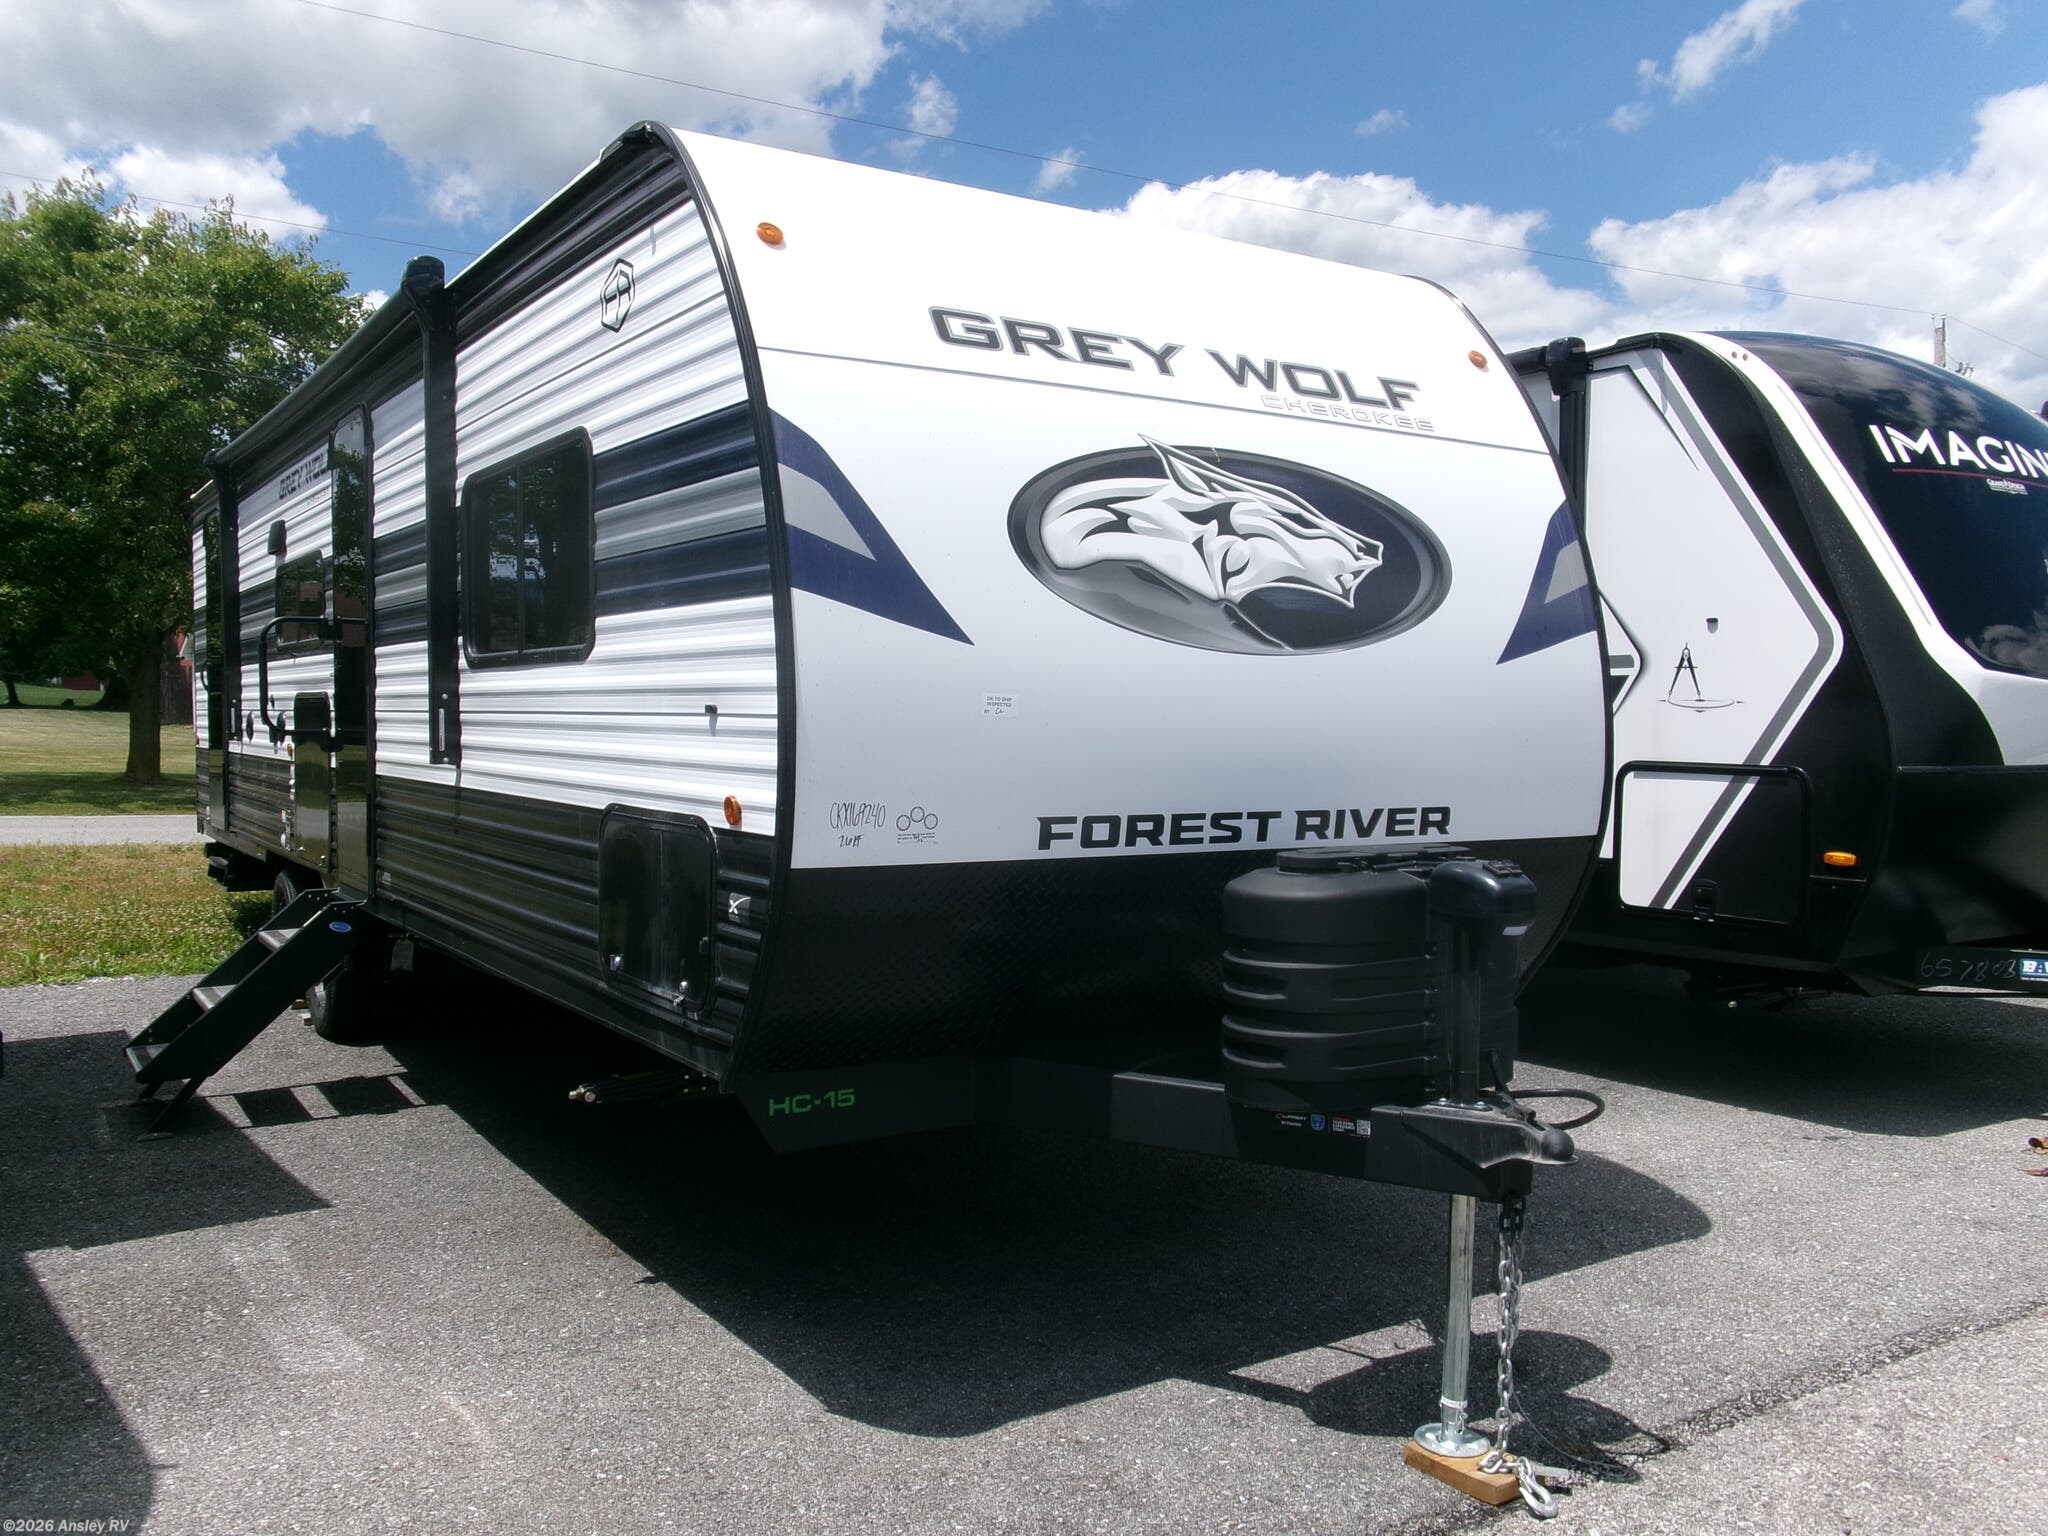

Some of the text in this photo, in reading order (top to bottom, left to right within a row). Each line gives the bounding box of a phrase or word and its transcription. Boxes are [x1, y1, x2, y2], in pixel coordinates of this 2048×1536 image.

[928, 306, 1421, 411] GREY WOLF
[1261, 394, 1436, 432] CHEROKEE
[1036, 806, 1451, 850] FOREST RIVER
